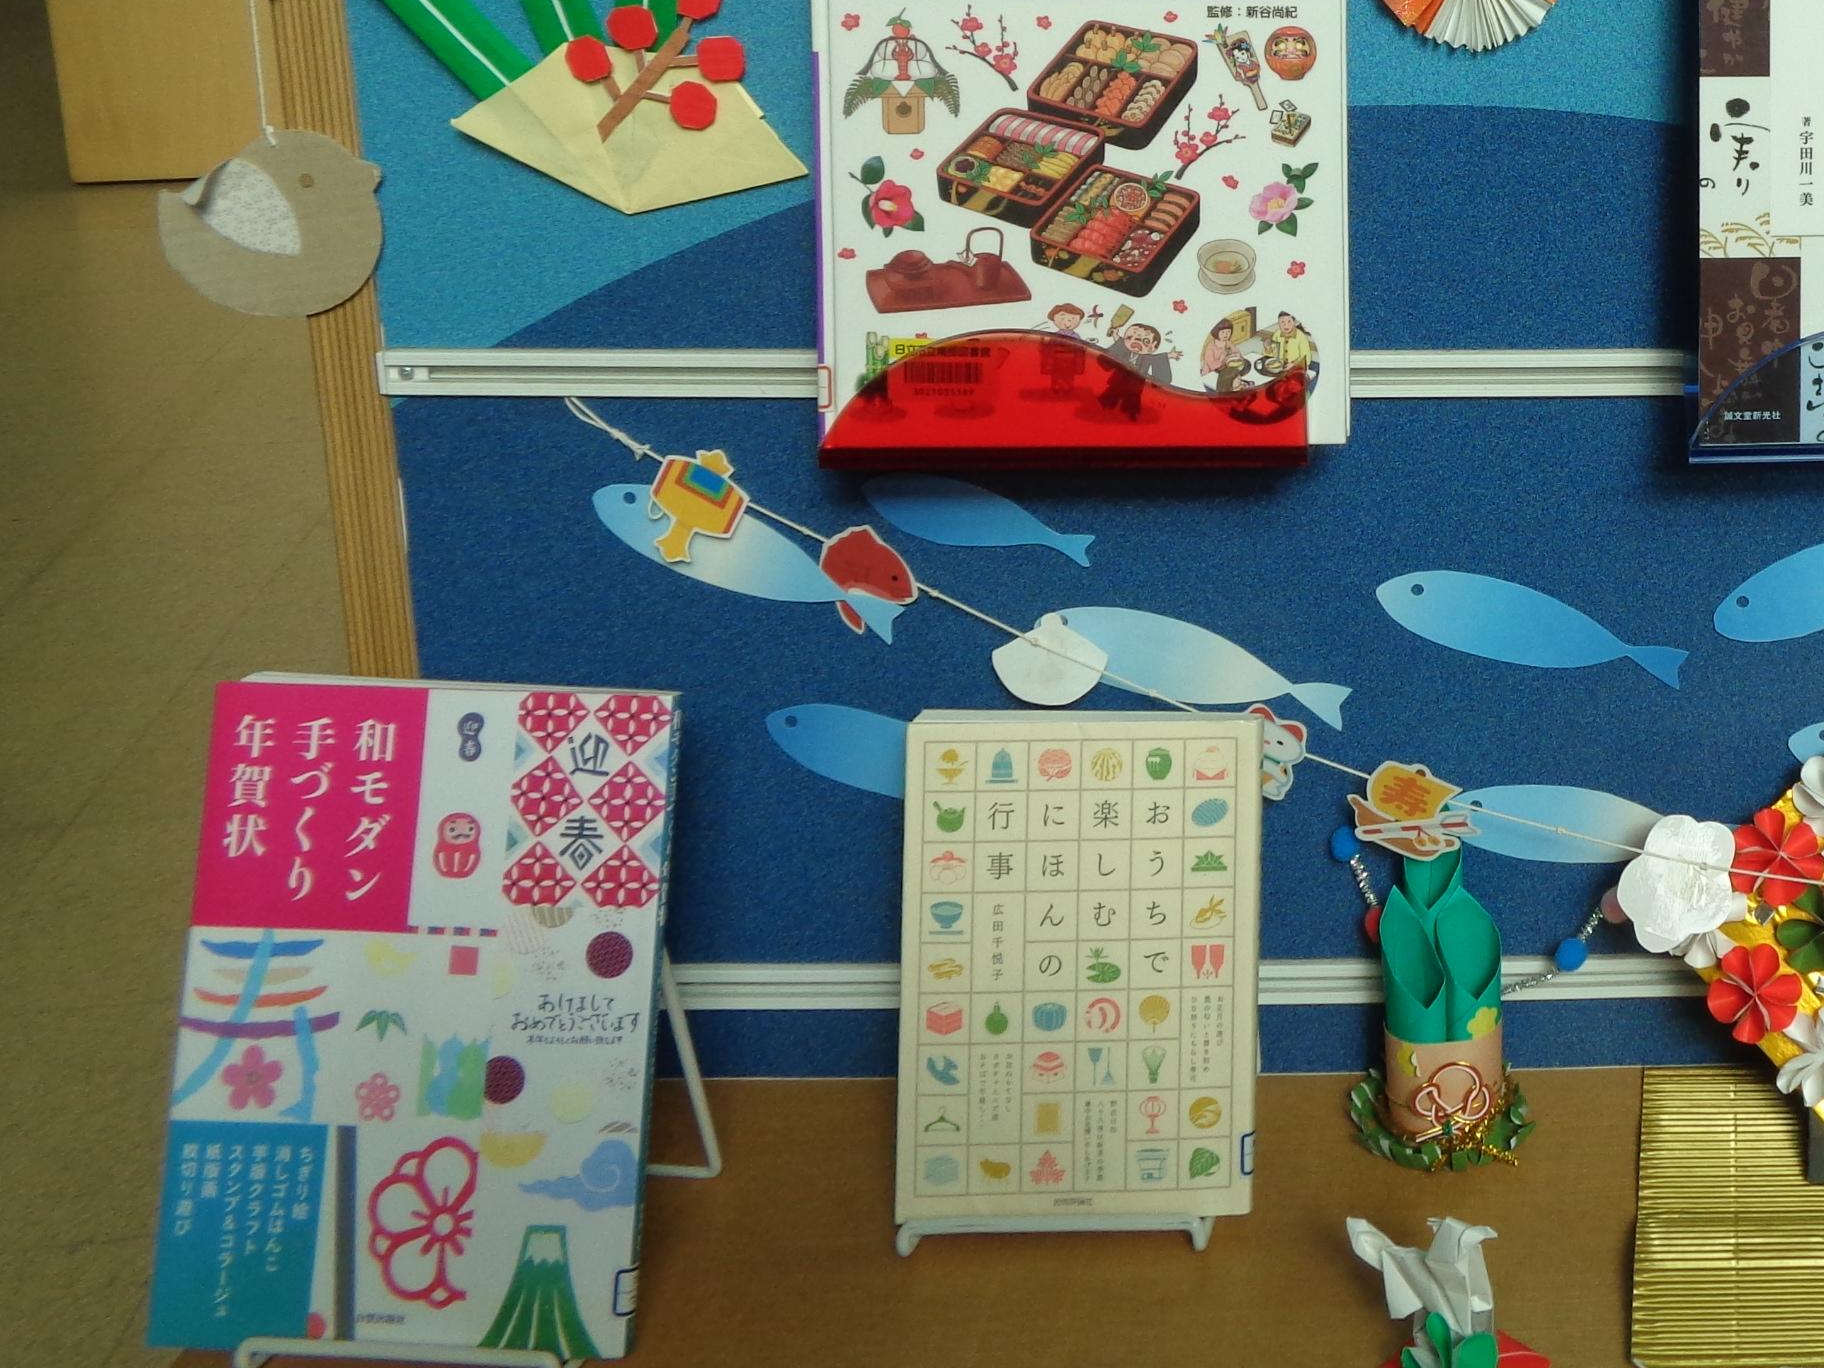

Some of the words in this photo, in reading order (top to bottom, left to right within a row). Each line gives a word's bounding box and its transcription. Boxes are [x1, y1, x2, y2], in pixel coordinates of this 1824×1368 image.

[1799, 130, 1814, 207] 宇田川一美
[222, 713, 275, 860] 年賀状
[287, 717, 336, 903] 手づくり
[345, 718, 396, 903] 和モダン
[558, 732, 611, 871] 迎春
[986, 801, 1016, 881] 行事
[1038, 802, 1066, 977] にほんの
[1092, 800, 1119, 928] 楽しむ
[1143, 799, 1171, 975] おうちで
[538, 992, 615, 1013] あけまして
